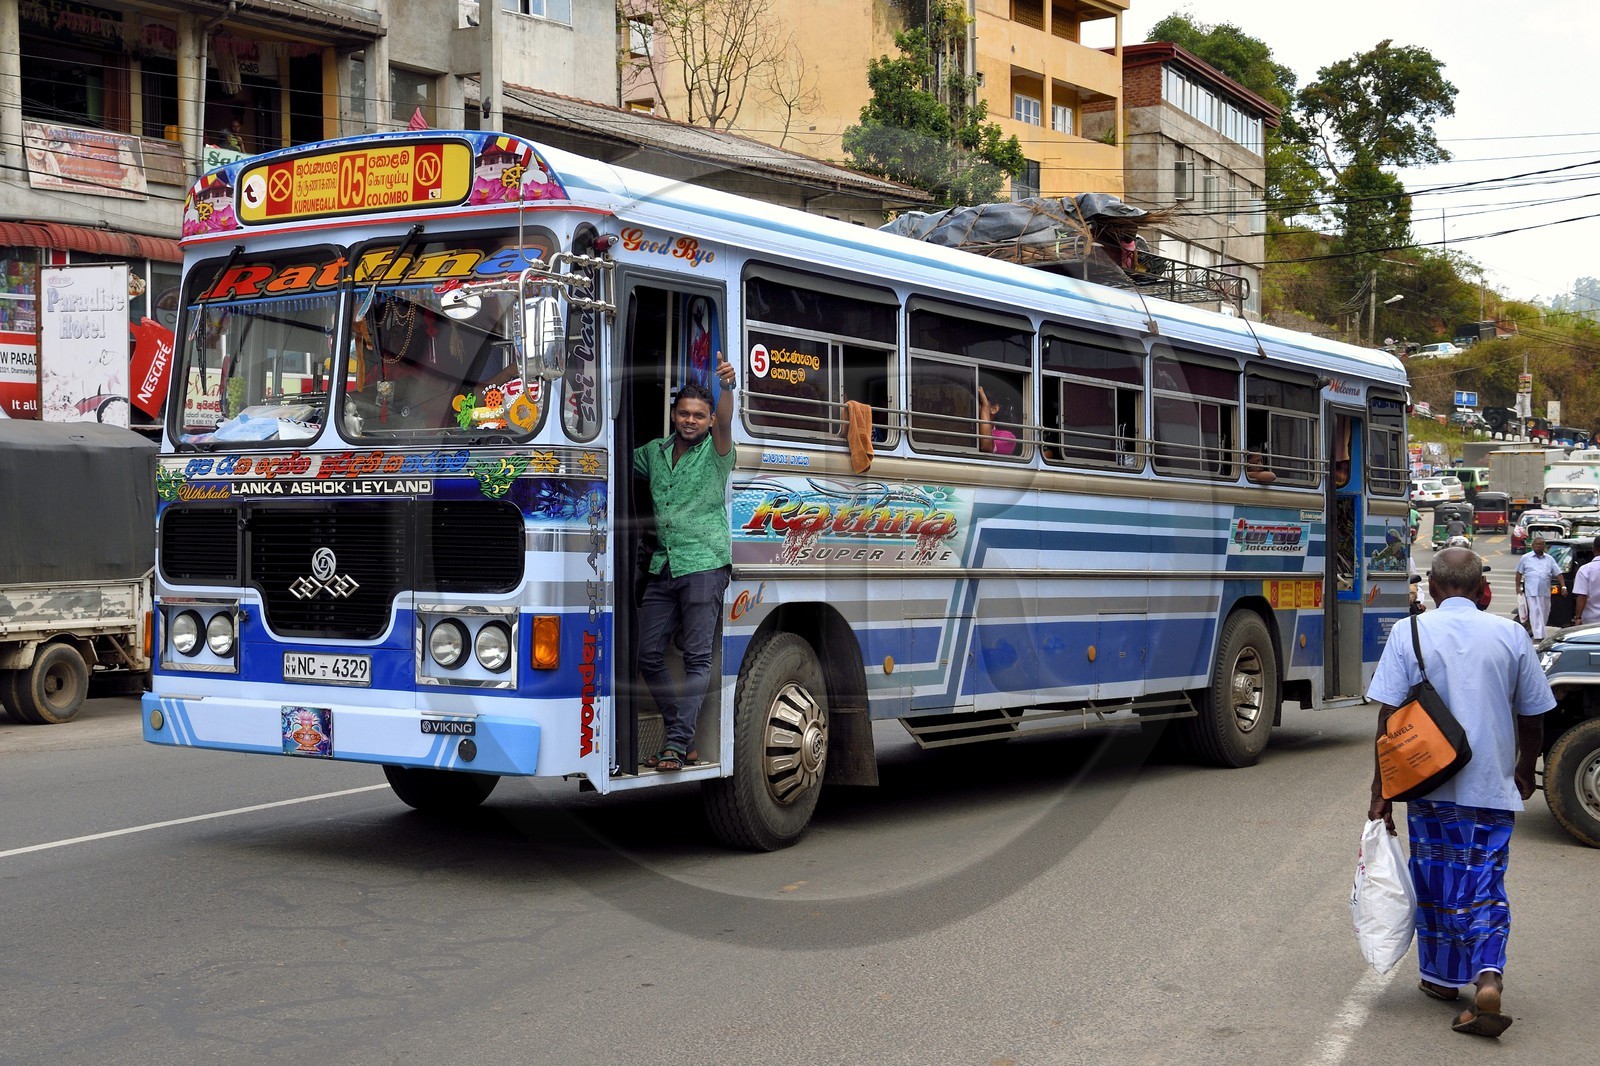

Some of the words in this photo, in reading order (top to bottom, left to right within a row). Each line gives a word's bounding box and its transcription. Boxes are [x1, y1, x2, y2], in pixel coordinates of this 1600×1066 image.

[368, 150, 410, 169] කොළඹ
[340, 157, 365, 206] 05
[294, 197, 336, 214] KURUNEGALA
[366, 190, 409, 207] COLOMBO
[620, 226, 673, 256] Good
[672, 236, 715, 268] Bye
[195, 245, 547, 303] Rathna
[47, 287, 125, 312] Paradise
[59, 314, 106, 339] Hotel
[137, 339, 172, 404] NESCAFÉ
[754, 350, 766, 373] 5
[770, 367, 806, 384] කොළඹ
[1328, 378, 1360, 397] Welcome
[12, 399, 21, 410] It
[23, 399, 38, 411] all
[177, 483, 231, 501] Uthshala
[231, 482, 284, 495] LANKA
[290, 481, 347, 494] ASHOK
[353, 480, 431, 494] LEYLAND
[742, 490, 959, 536] Rathna
[1234, 519, 1302, 545] turbo
[796, 548, 885, 561] SUPER
[895, 549, 953, 562] LINE
[1246, 544, 1303, 552] Intercooler
[586, 579, 598, 624] of
[729, 581, 766, 622] Out
[298, 656, 316, 675] NC
[332, 658, 367, 678] 4329
[579, 630, 596, 758] wonder
[431, 722, 472, 734] VIKING
